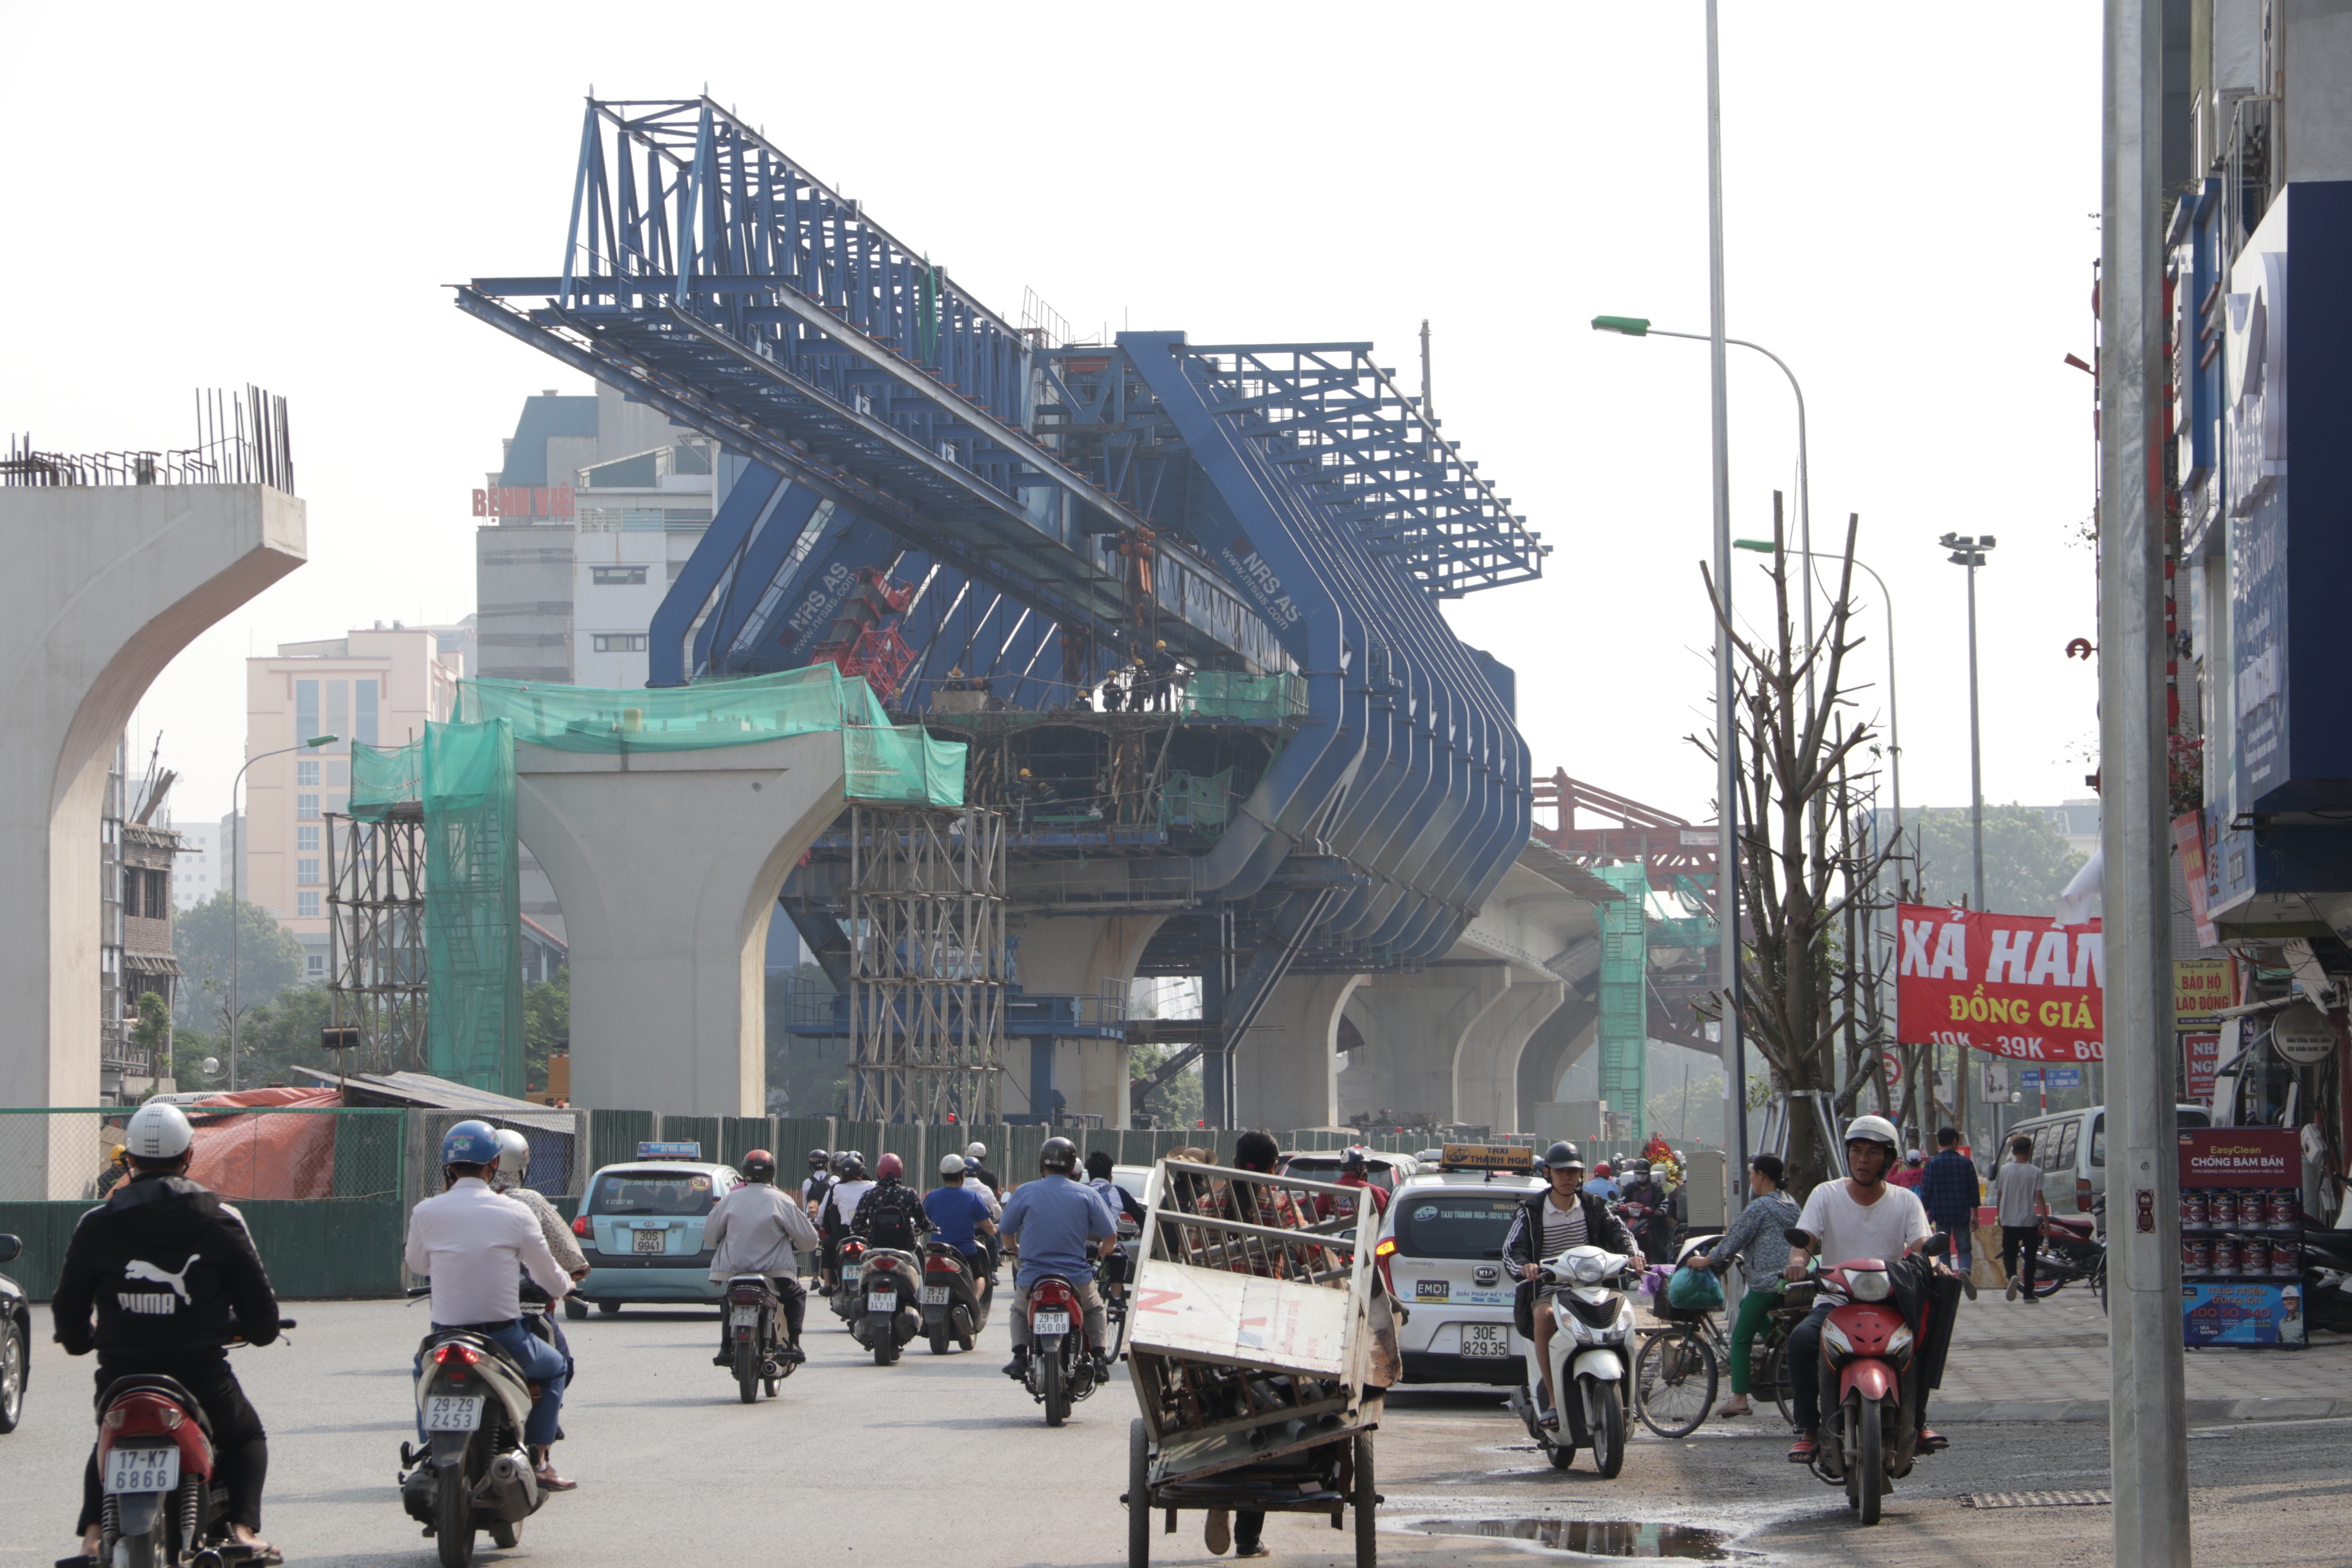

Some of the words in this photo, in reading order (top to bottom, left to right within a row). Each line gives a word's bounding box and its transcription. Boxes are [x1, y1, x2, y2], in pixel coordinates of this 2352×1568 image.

[472, 481, 531, 522] BỆNH
[1221, 547, 1289, 631] www.nrsas.com
[1243, 551, 1280, 595] NRS
[1273, 595, 1302, 622] AS
[789, 590, 826, 632] NRS
[822, 561, 848, 593] AS
[791, 572, 855, 655] www.nrsas.com
[1900, 909, 1968, 981] XẢ
[2182, 970, 2203, 989] BẢO
[2207, 972, 2221, 992] HỘ
[1949, 984, 2030, 1024] ĐỒNG
[2039, 995, 2095, 1029] GIÁ
[2175, 997, 2196, 1011] LAO
[1930, 1031, 1971, 1047] 10K
[1997, 1036, 2045, 1059] 39K
[661, 1142, 678, 1153] SÔNG
[2210, 1146, 2261, 1155] EasyClean
[1470, 1155, 1504, 1164] THANH
[640, 1231, 658, 1241] 30S
[638, 1241, 659, 1250] 9941
[117, 1292, 176, 1315] PUMA
[2191, 1308, 2218, 1318] 100
[2222, 1308, 2239, 1318] 50
[2243, 1308, 2271, 1318] 340
[1036, 1323, 1066, 1332] 950.08
[1473, 1327, 1497, 1340] 30E
[1463, 1341, 1506, 1355] 829.35
[433, 1397, 473, 1412] 29-Z9
[431, 1413, 472, 1428] 2453
[119, 1450, 168, 1469] 17-K7
[116, 1469, 167, 1489] 6866
